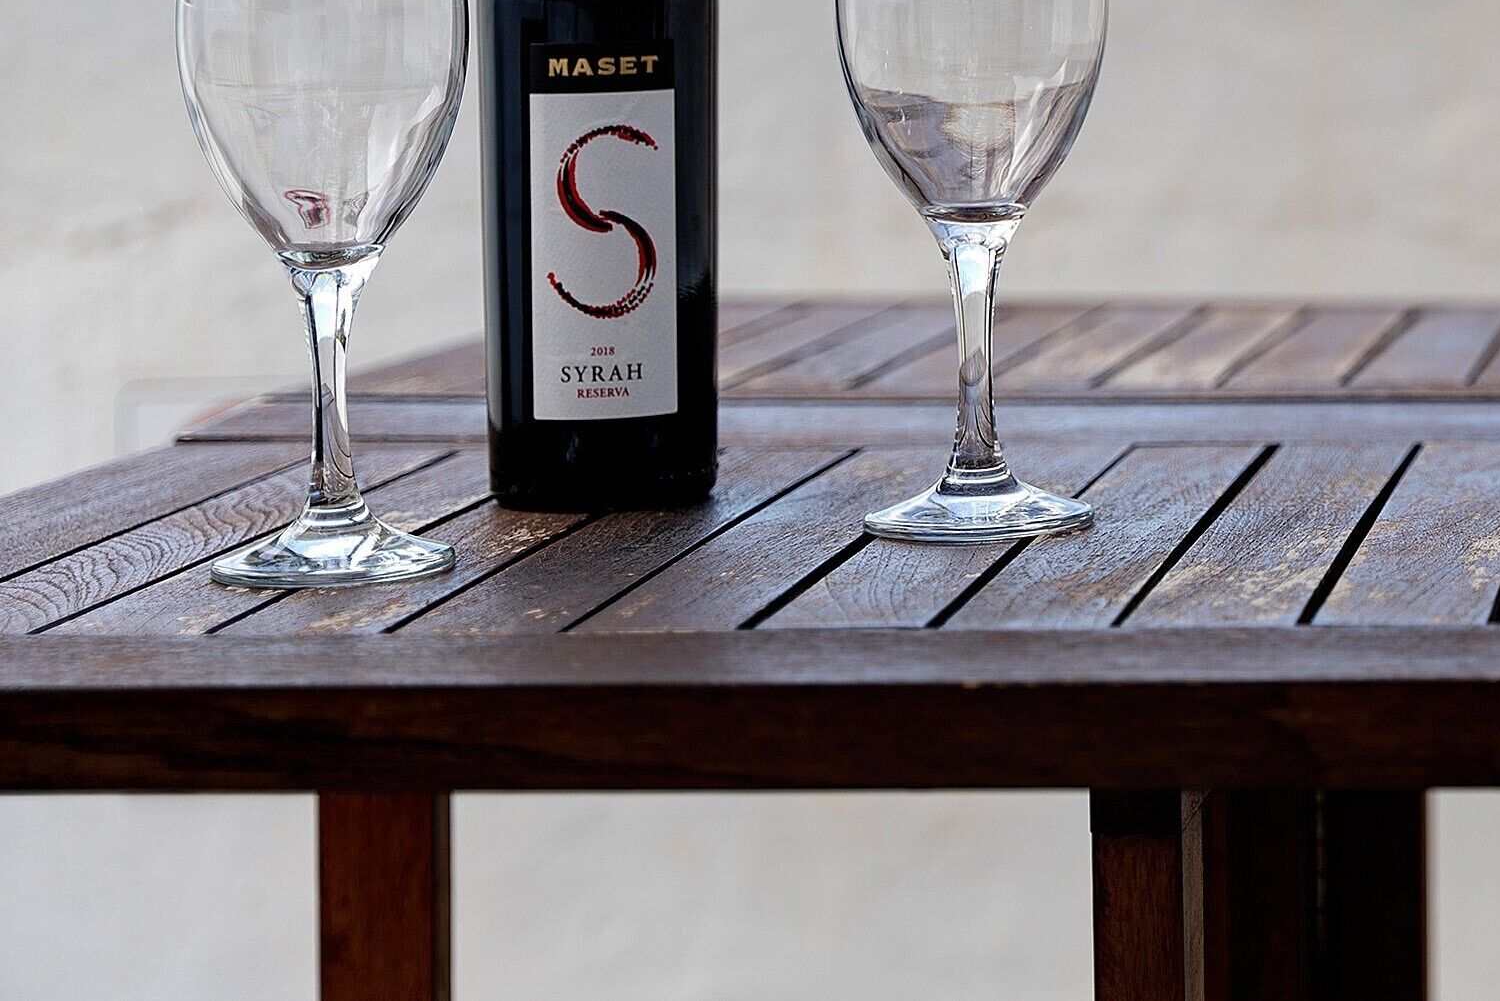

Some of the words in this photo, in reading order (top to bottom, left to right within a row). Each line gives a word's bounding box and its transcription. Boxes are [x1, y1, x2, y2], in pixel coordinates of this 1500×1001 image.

[547, 54, 659, 76] MASET
[547, 124, 659, 320] S
[589, 345, 616, 356] 2018
[558, 363, 644, 383] SYRAH
[576, 387, 631, 399] RESERVA
